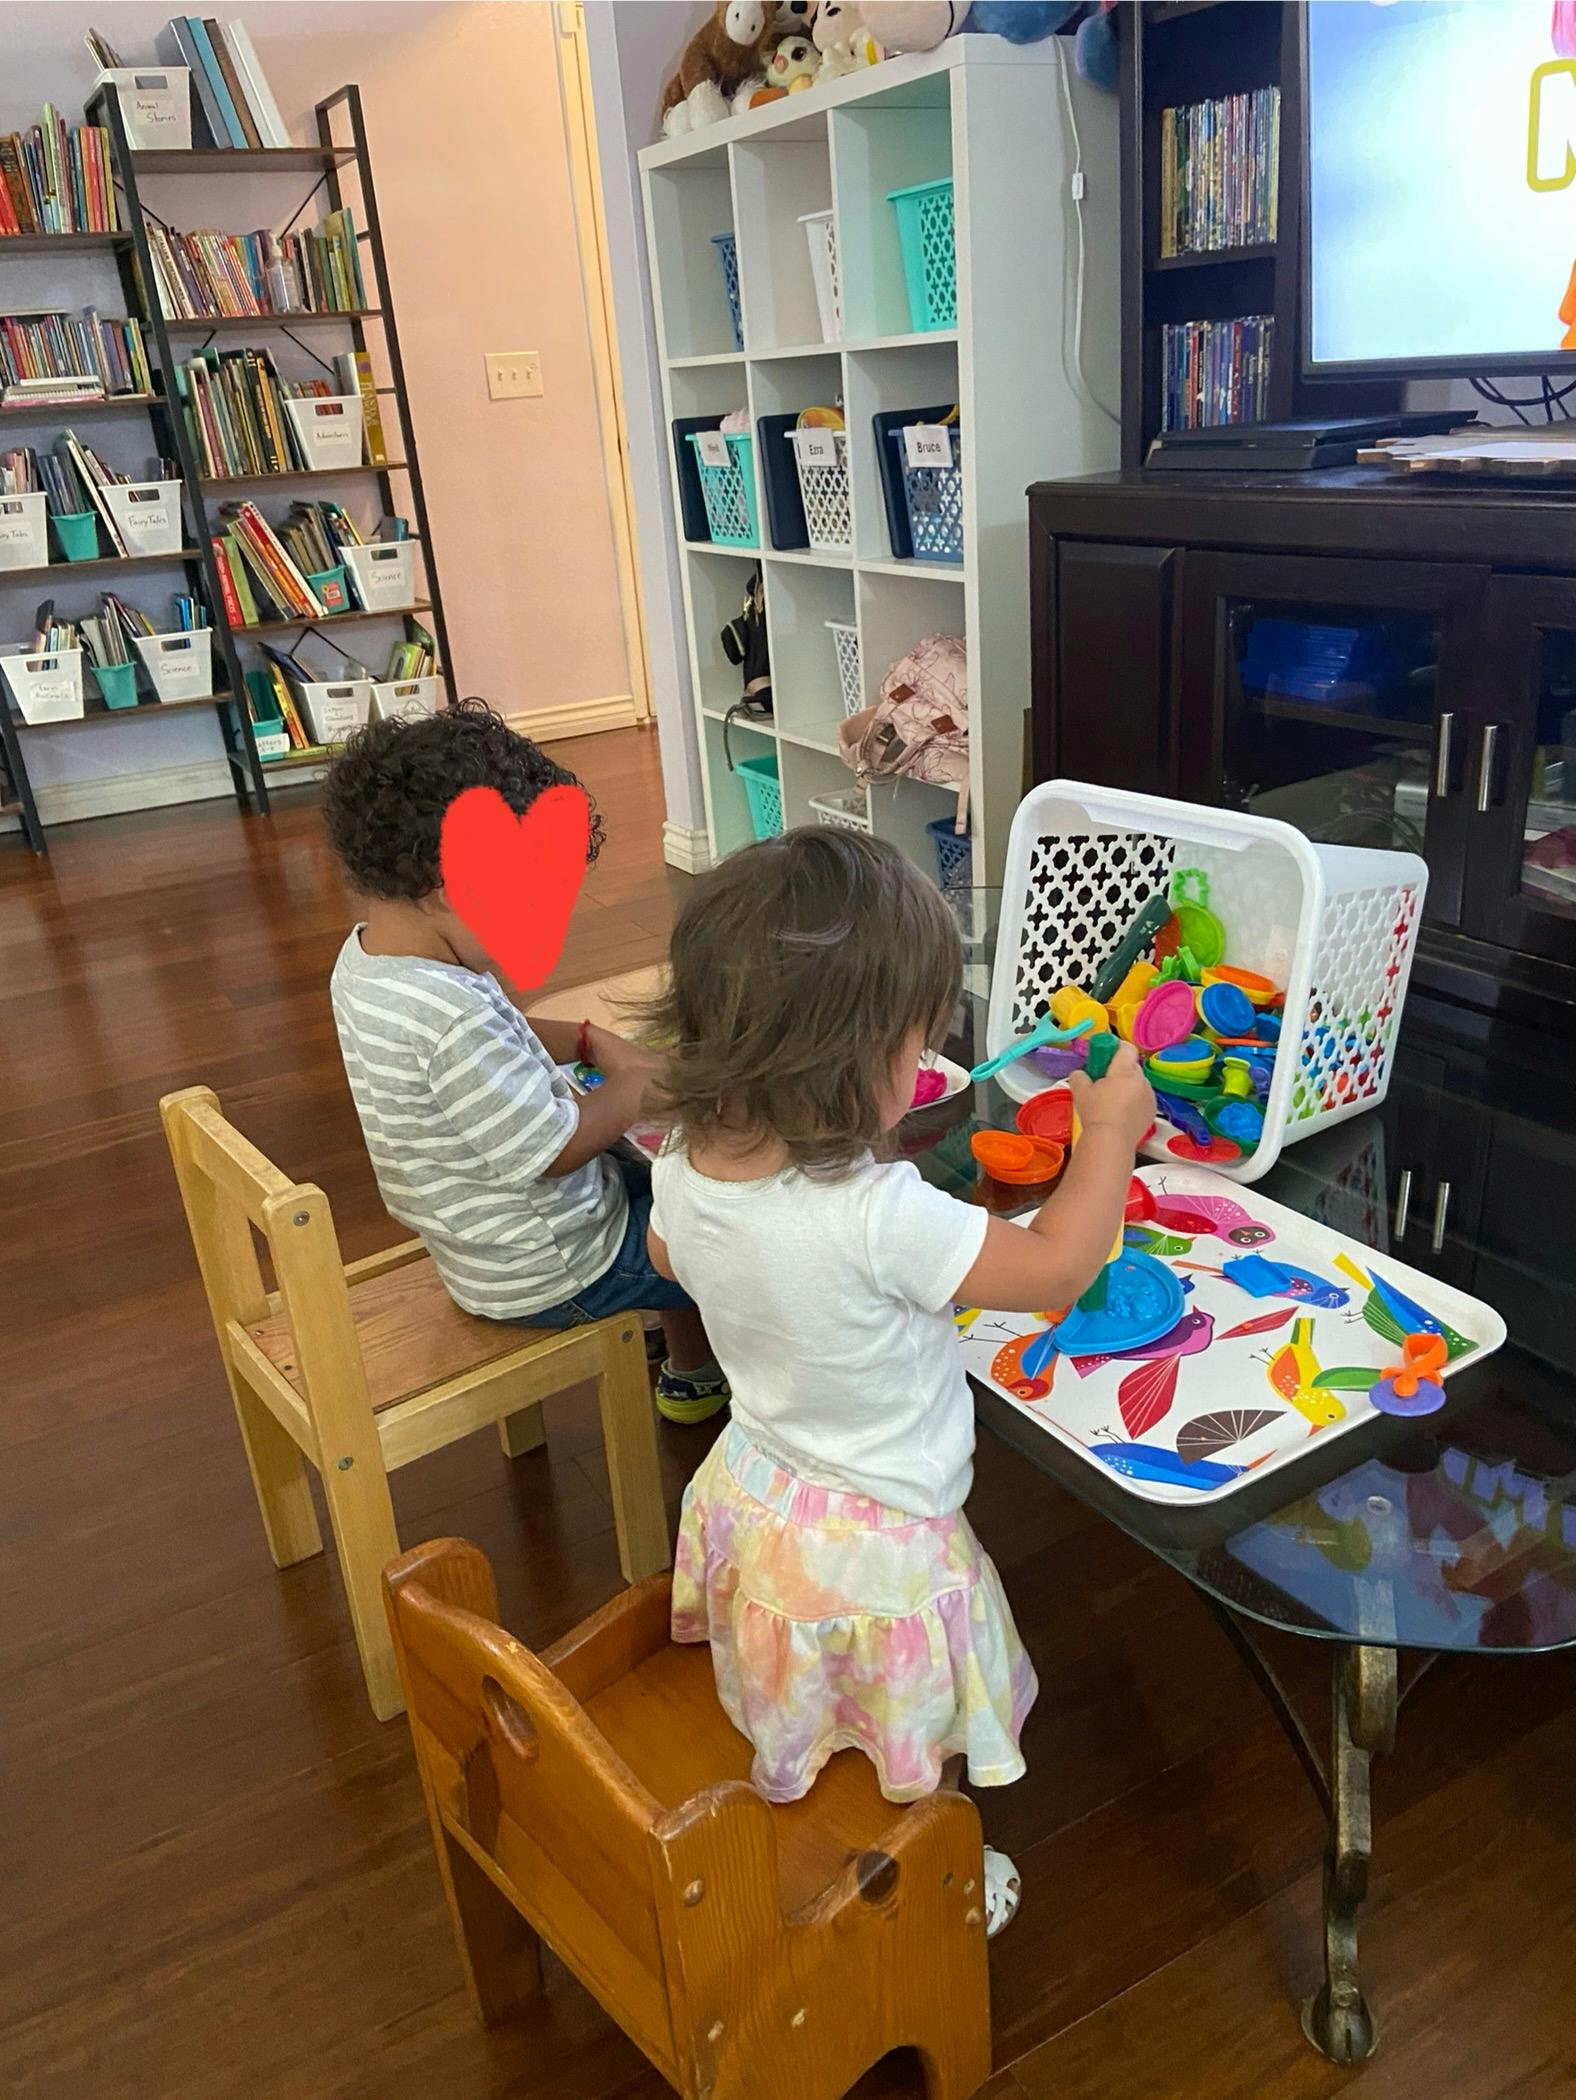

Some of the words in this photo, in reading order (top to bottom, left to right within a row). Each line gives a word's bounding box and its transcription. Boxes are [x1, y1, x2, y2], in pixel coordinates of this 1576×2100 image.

[808, 444, 824, 455] Ezra
[916, 441, 942, 454] Bruce
[370, 571, 401, 584] Science
[160, 662, 193, 676] Science
